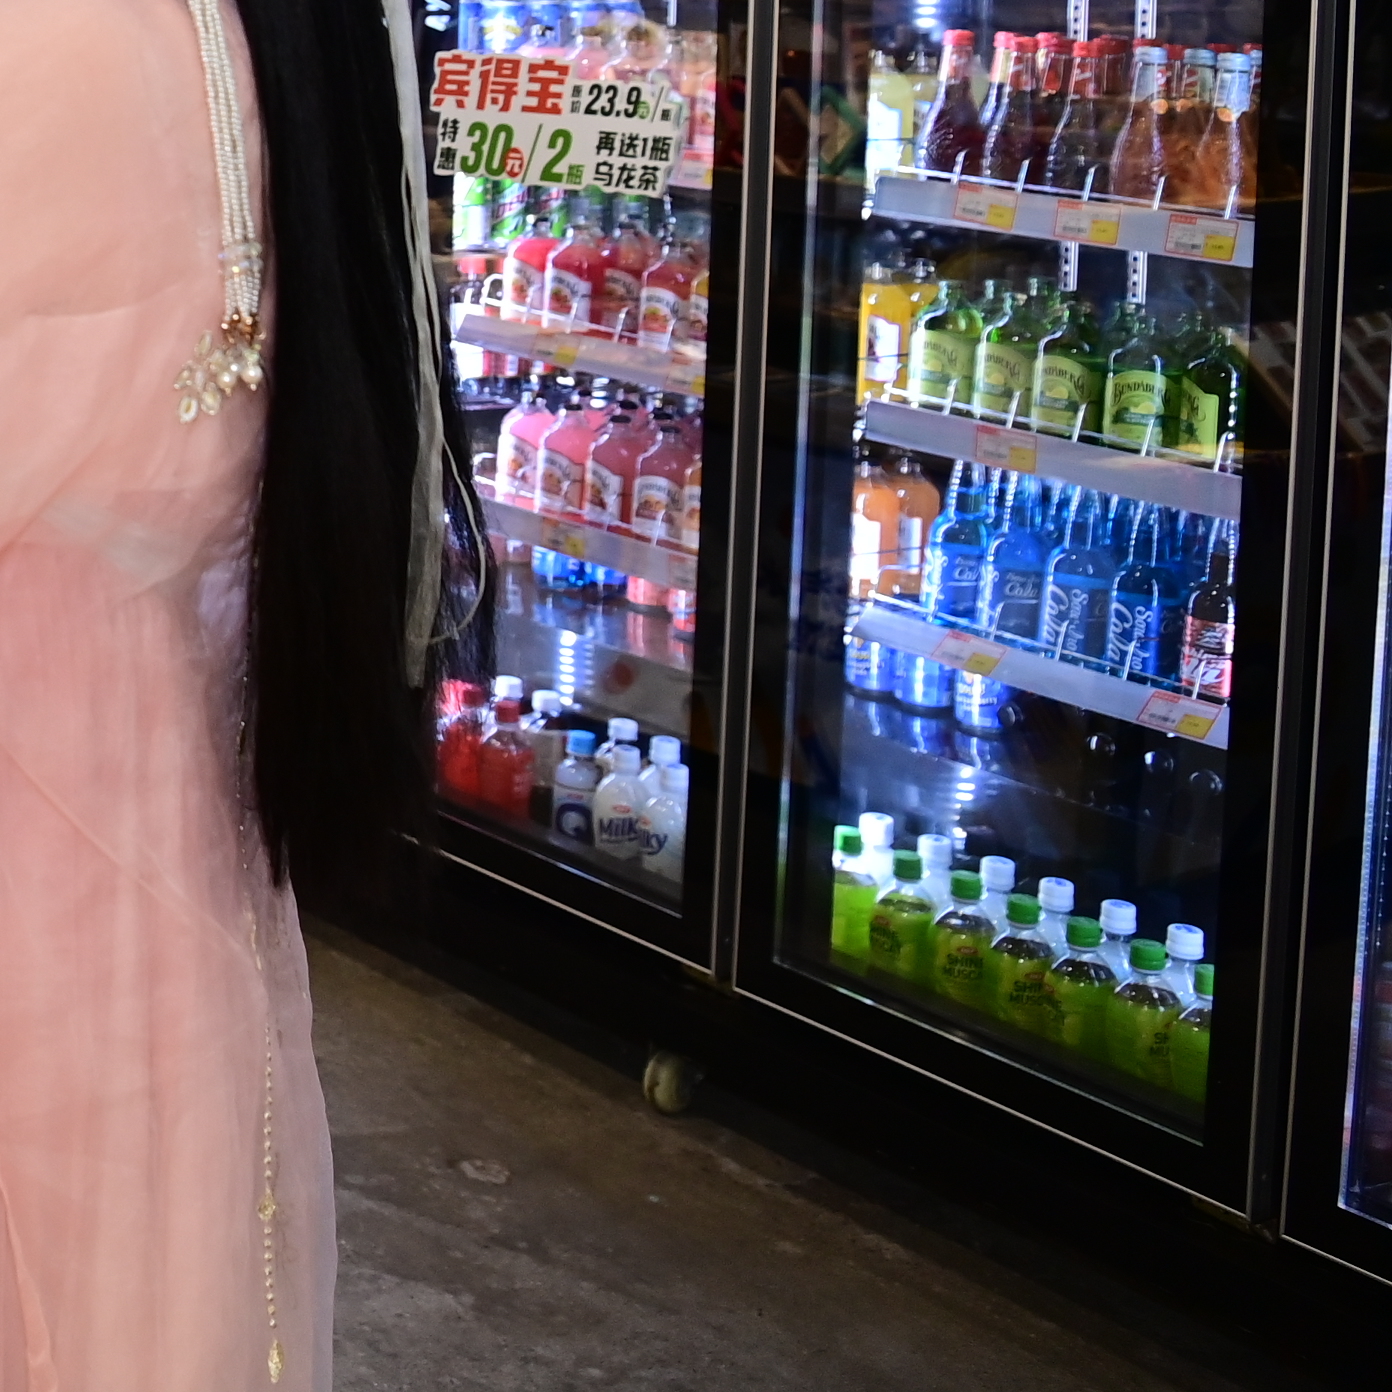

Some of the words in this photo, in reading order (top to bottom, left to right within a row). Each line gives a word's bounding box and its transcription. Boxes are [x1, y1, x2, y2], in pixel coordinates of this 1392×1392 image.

[433, 54, 569, 116] 宾得宝
[437, 118, 461, 171] 特惠
[595, 130, 674, 162] 再送1瓶
[593, 161, 661, 192] 乌龙茶
[599, 816, 639, 844] Milk
